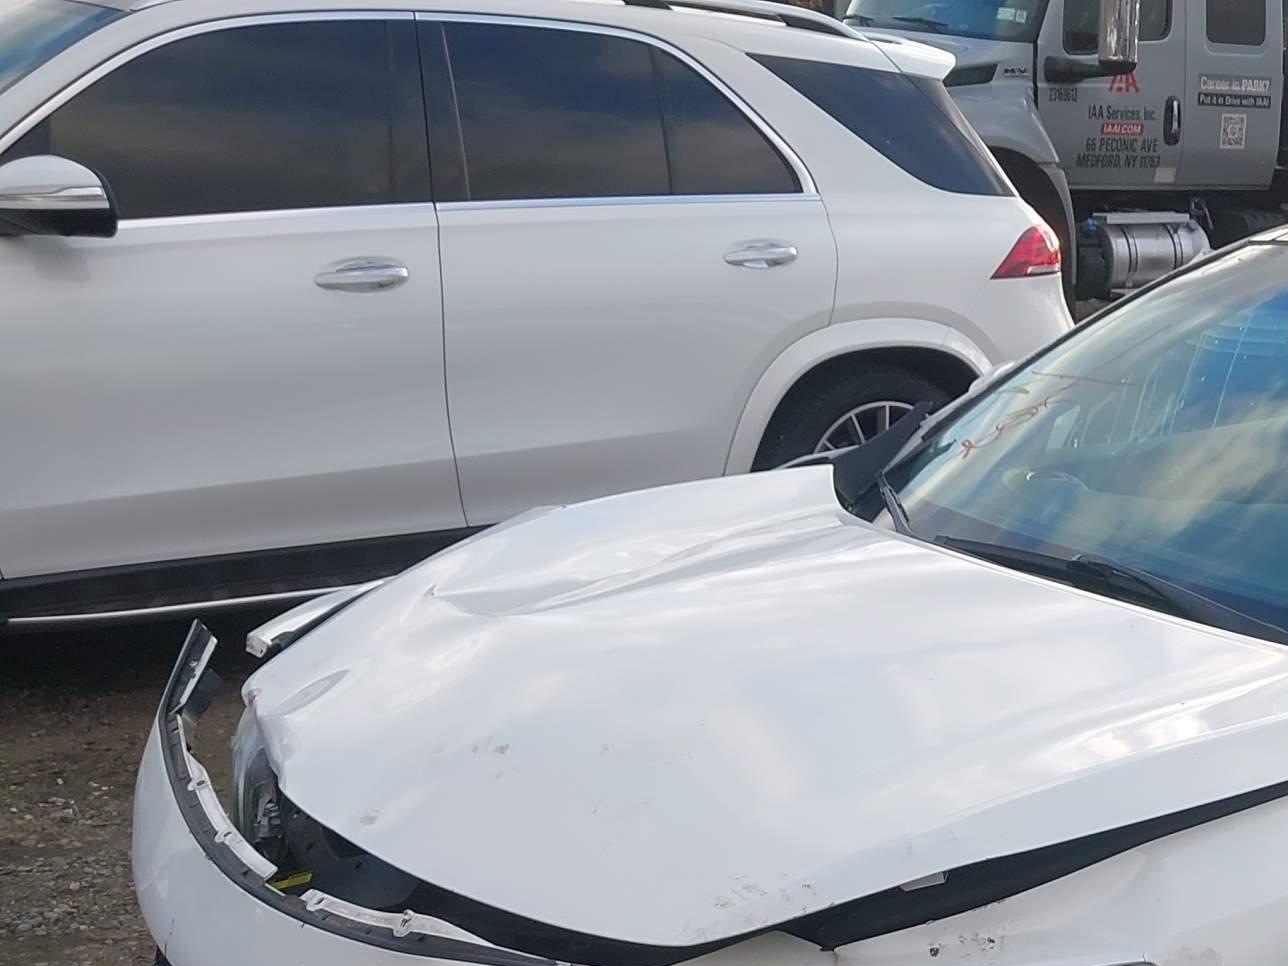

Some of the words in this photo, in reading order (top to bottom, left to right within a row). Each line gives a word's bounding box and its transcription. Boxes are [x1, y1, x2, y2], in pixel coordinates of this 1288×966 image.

[1200, 75, 1230, 90] Career
[1241, 79, 1271, 92] PARK?
[1088, 103, 1104, 120] IAA
[1085, 137, 1097, 152] 66
[1098, 137, 1138, 153] PECONIC
[1140, 138, 1158, 153] AVE
[1123, 154, 1138, 168] NY
